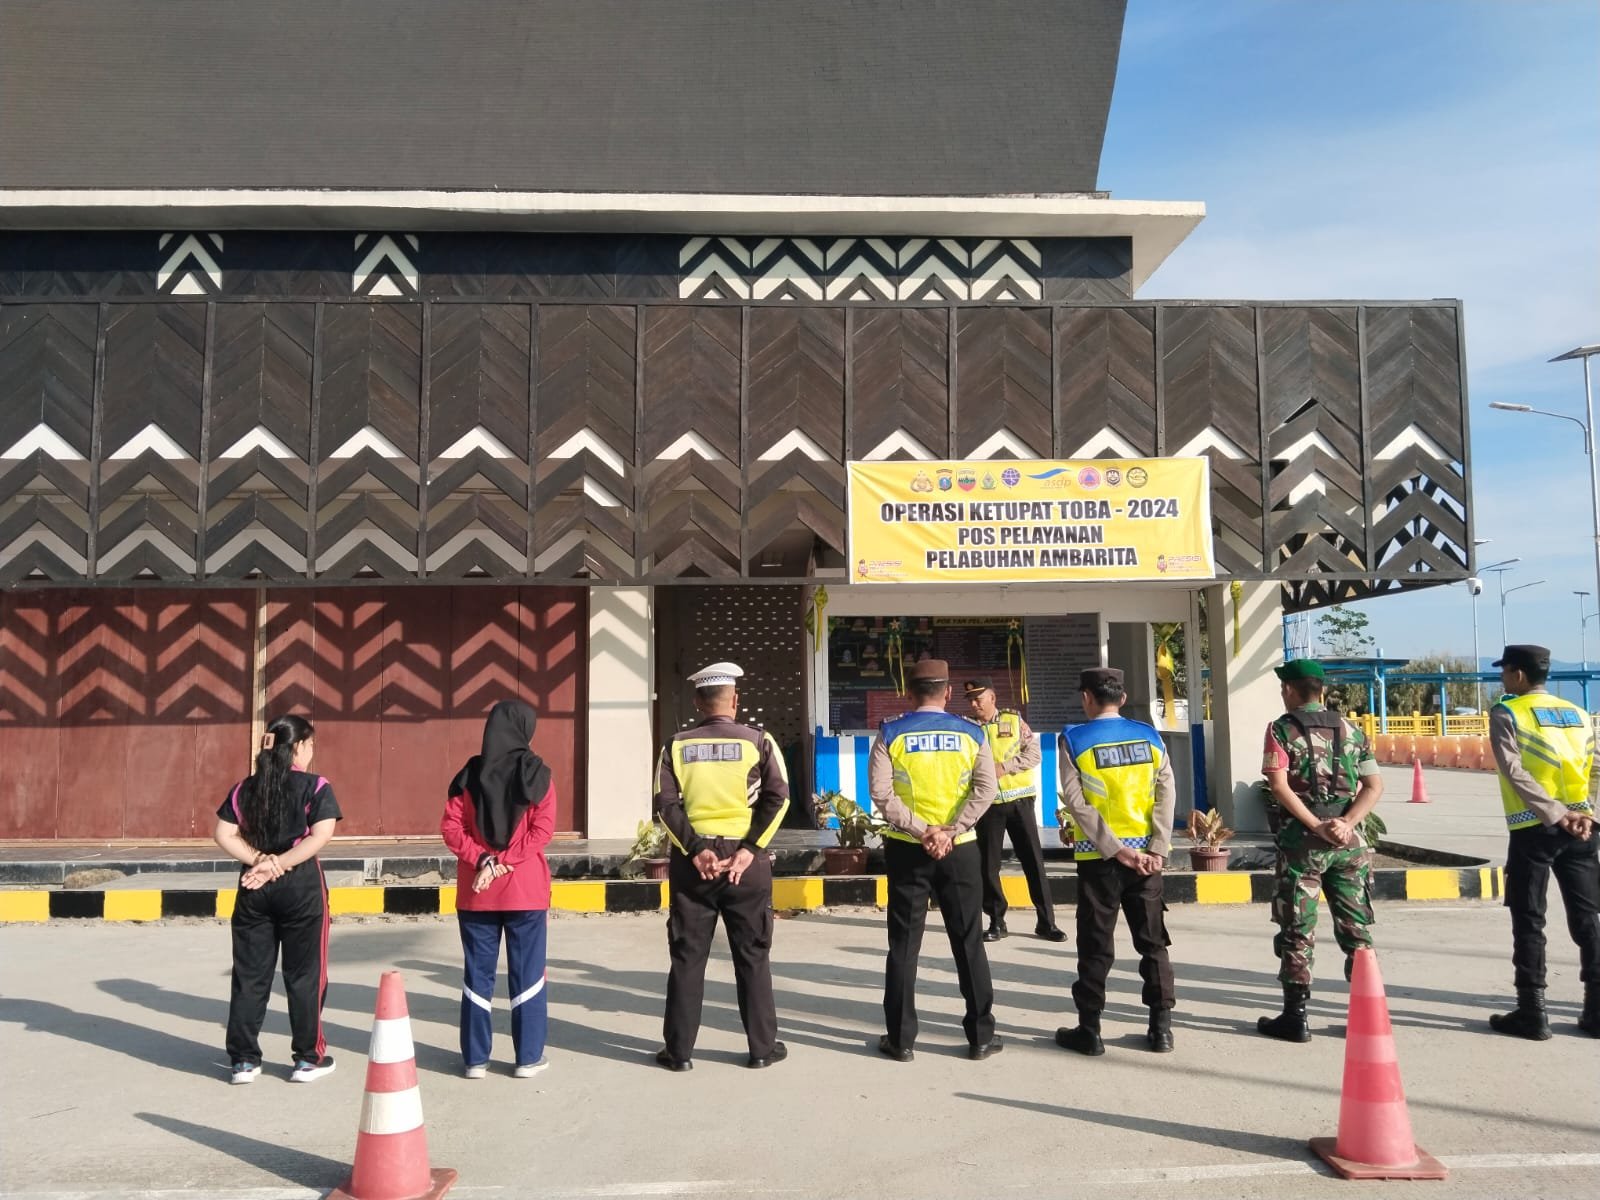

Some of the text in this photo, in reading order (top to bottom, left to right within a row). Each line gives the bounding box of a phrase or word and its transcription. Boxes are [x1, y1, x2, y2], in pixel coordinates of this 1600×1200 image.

[881, 502, 963, 522] OPERASI
[970, 502, 1052, 521] KETUPAT
[1058, 500, 1111, 519] TOBA
[1128, 498, 1179, 517] 2024
[958, 526, 1103, 545] POS PELAYANAN
[926, 550, 1034, 568] PELABUHAN
[1040, 548, 1137, 566] AMBARITA
[684, 744, 741, 761] POLISI
[907, 735, 961, 752] POLISI
[1097, 743, 1150, 766] POLISI
